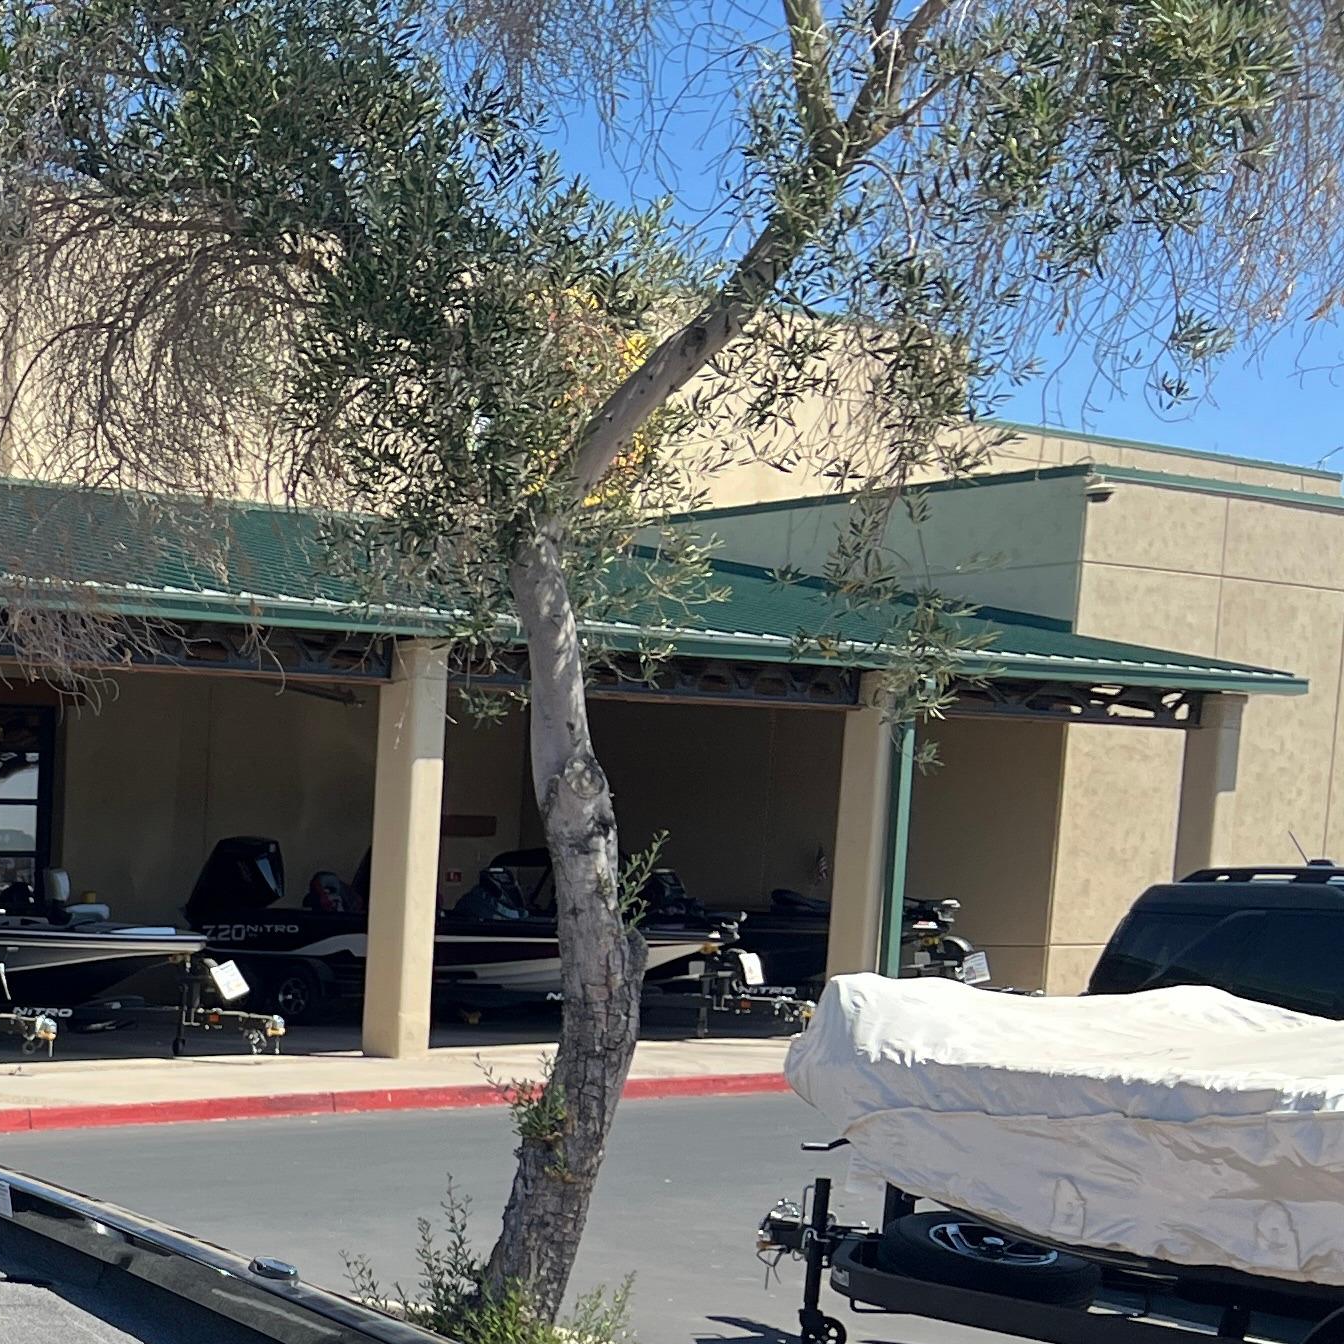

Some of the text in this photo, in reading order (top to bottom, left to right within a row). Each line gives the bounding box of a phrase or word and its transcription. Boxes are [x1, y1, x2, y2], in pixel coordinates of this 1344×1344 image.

[202, 924, 300, 941] Z20 NITRO
[13, 1006, 73, 1018] NITRO
